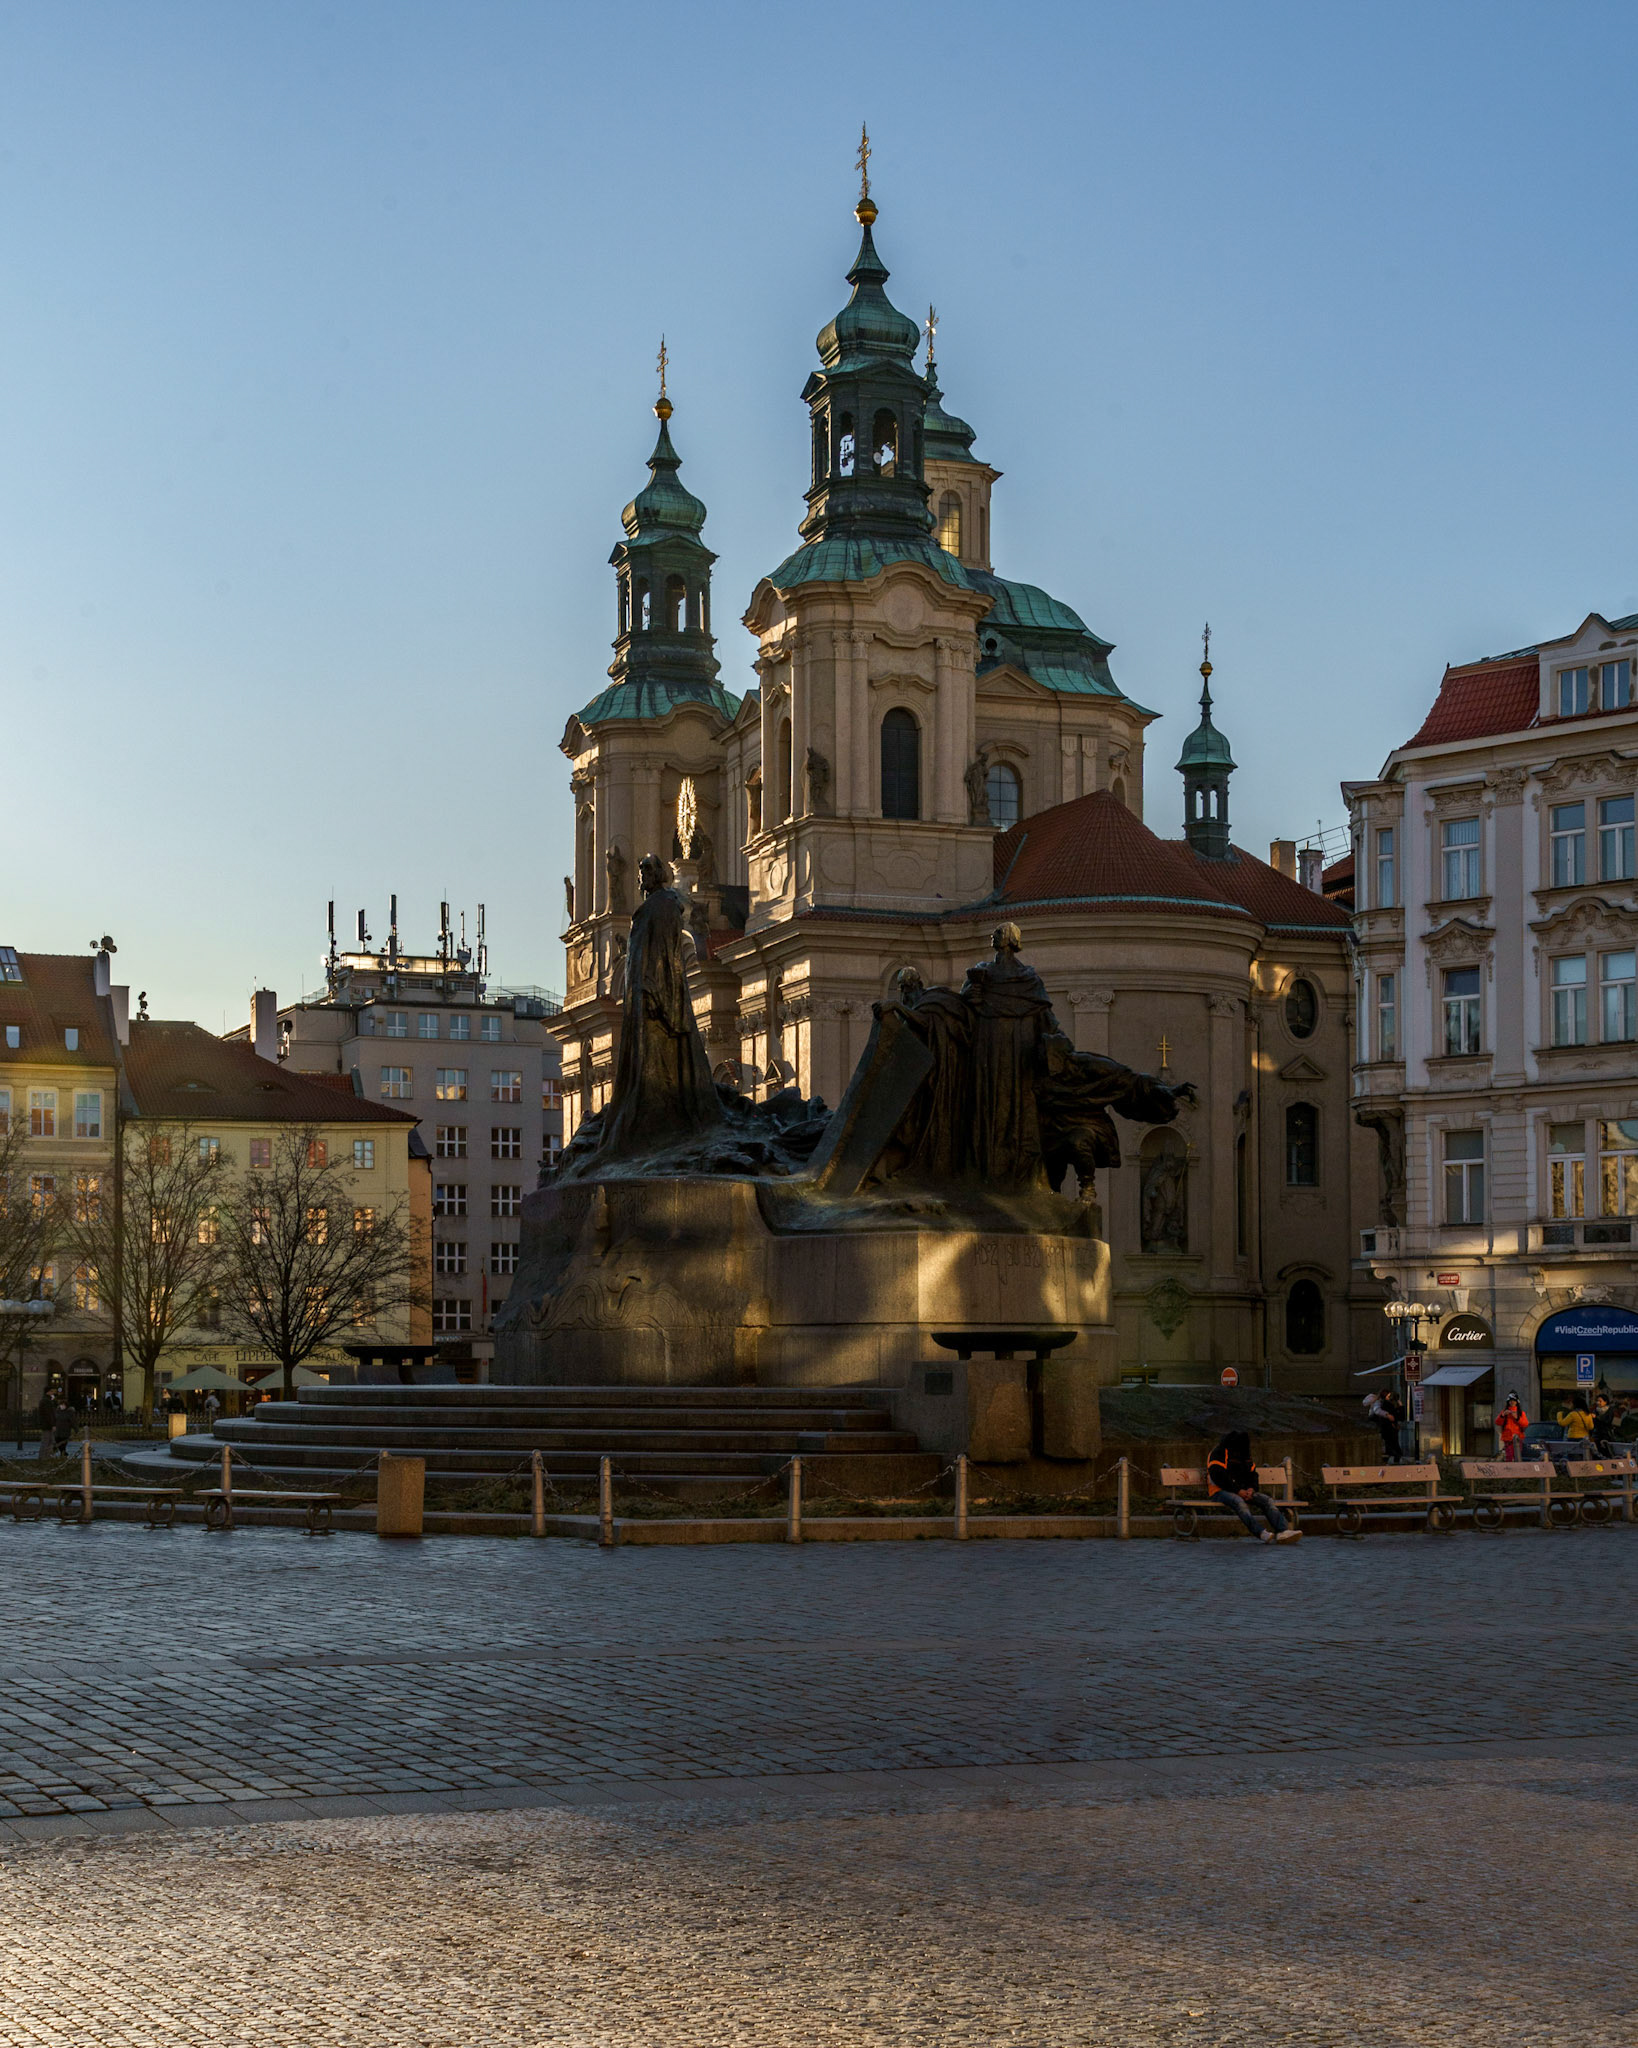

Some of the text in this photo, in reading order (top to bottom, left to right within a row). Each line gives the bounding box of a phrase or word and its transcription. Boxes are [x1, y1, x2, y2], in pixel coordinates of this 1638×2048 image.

[1447, 1327, 1486, 1342] Cartier
[1554, 1325, 1638, 1336] #VisitCzechRepublic
[235, 1350, 282, 1362] LIPPER
[1580, 1357, 1591, 1373] P
